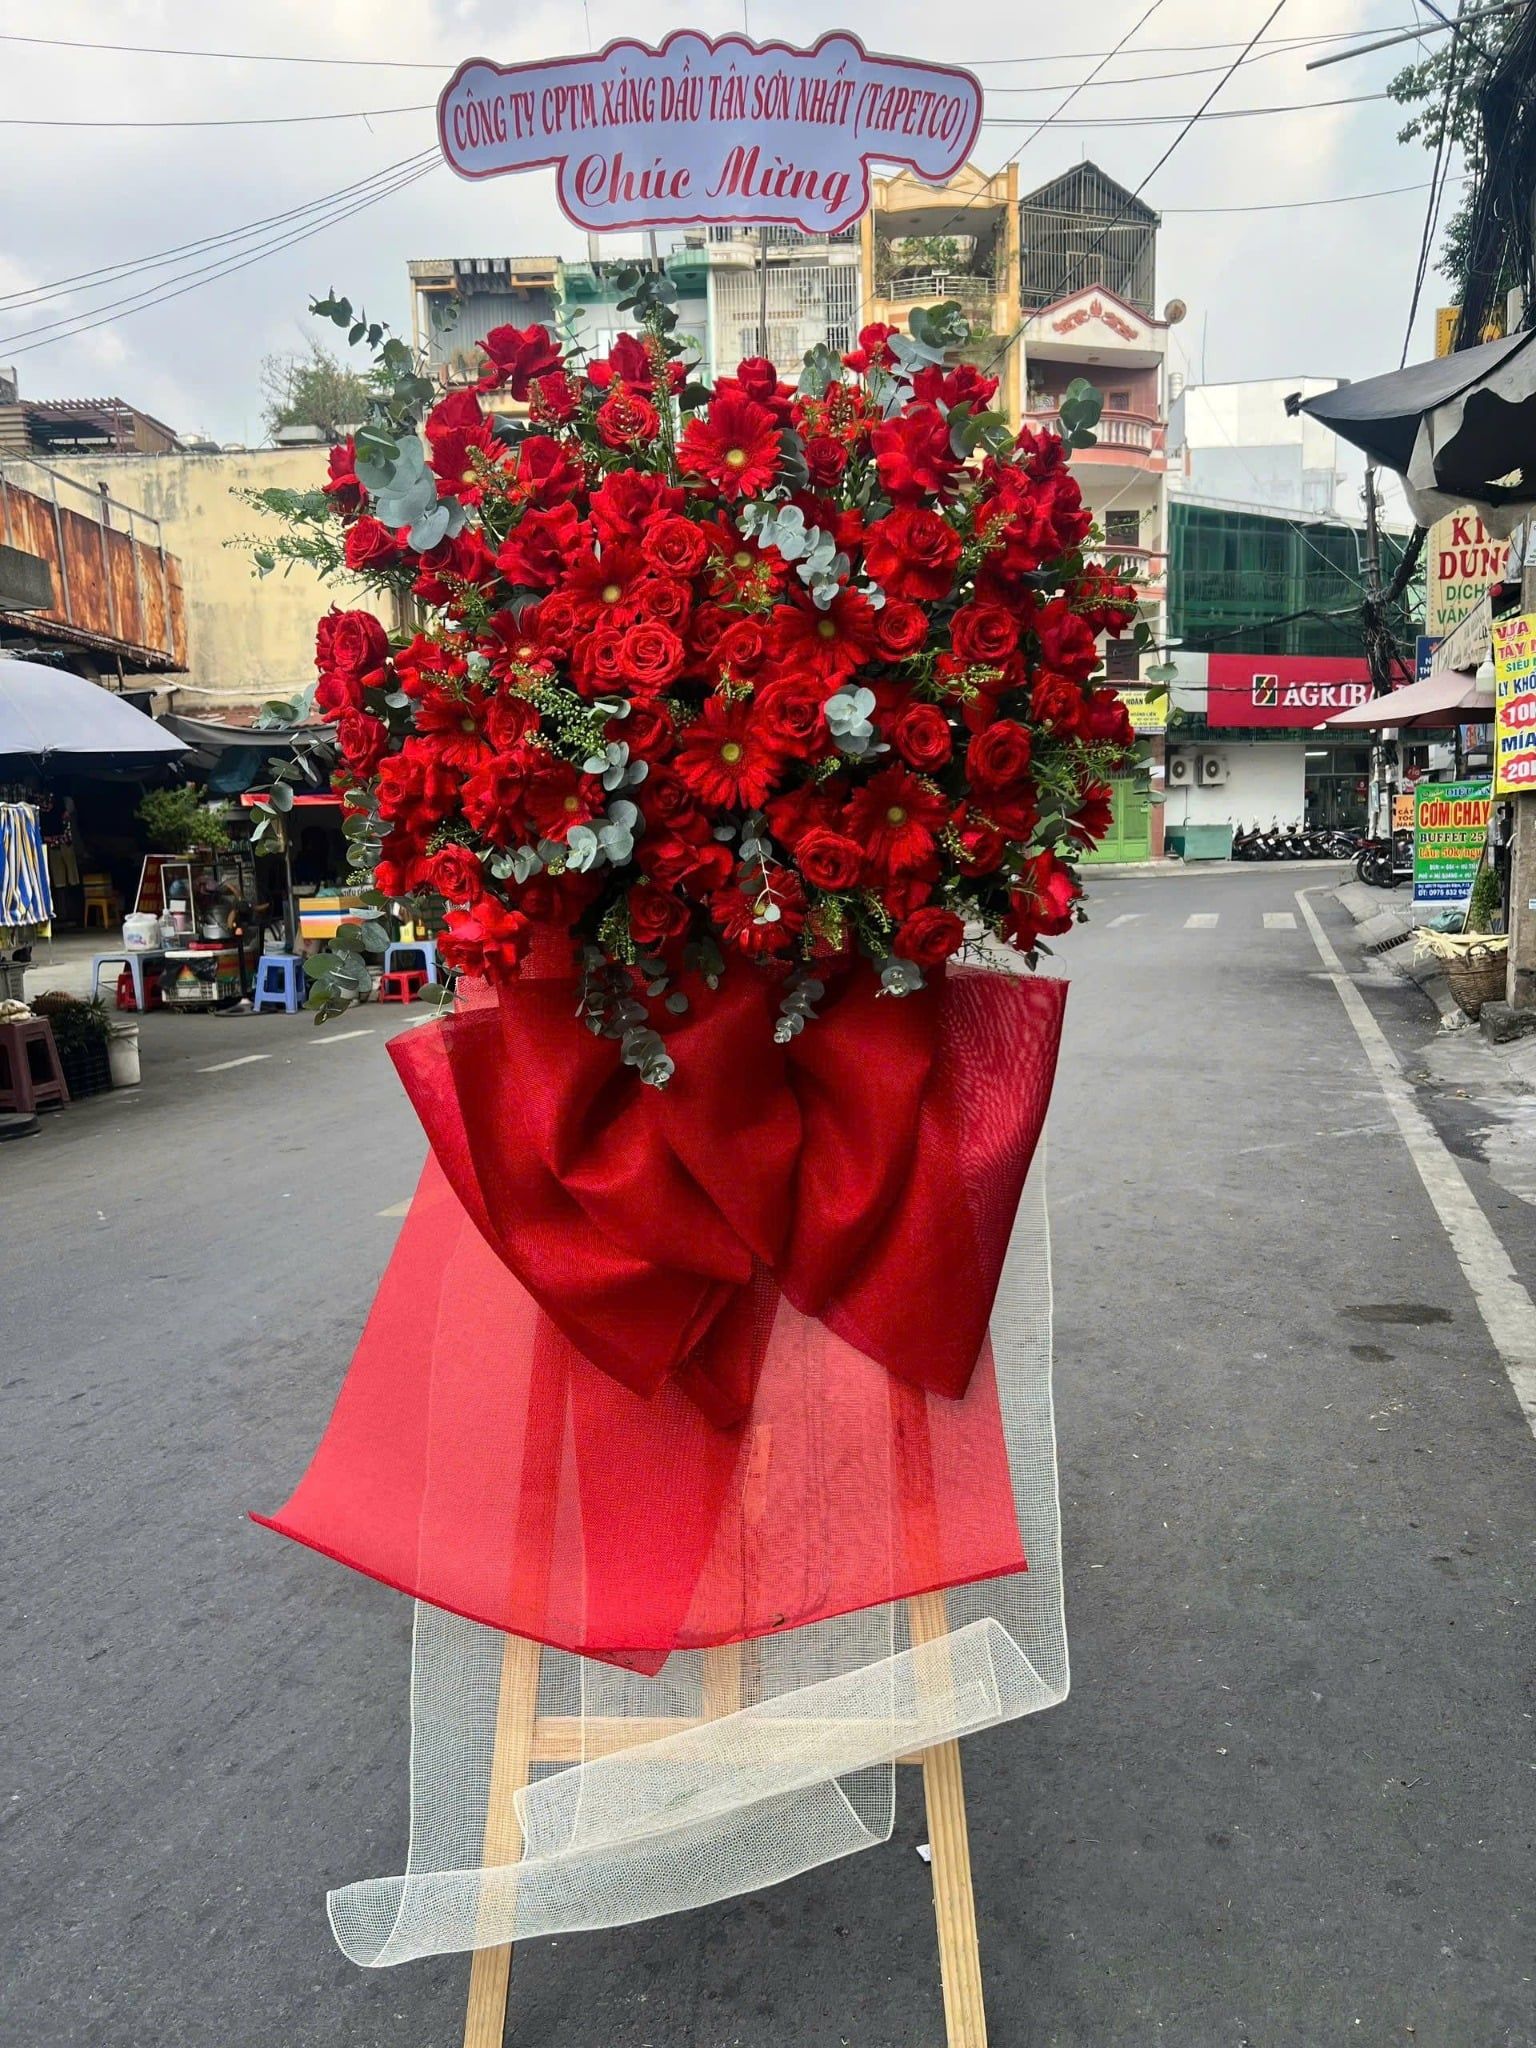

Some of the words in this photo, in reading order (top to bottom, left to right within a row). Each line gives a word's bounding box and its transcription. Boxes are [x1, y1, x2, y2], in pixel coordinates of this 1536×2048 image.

[453, 88, 507, 151] CÔNG
[510, 90, 535, 139] TY
[542, 83, 598, 135] CPTM
[601, 66, 656, 127] XĂNG
[660, 55, 704, 122] DẦU
[708, 63, 749, 121] TÂN
[751, 69, 794, 121] SƠN
[795, 59, 855, 126] NHẤT
[854, 82, 969, 153] (TAPETCO)
[575, 152, 692, 208] Chúc
[705, 145, 852, 214] Mừng
[1282, 681, 1408, 707] AGRIB
[1498, 681, 1509, 697] LY
[1501, 731, 1536, 752] MÍA
[1420, 800, 1450, 827] CƠM
[1453, 801, 1490, 827] CHAY
[1420, 832, 1466, 842] BUFFET
